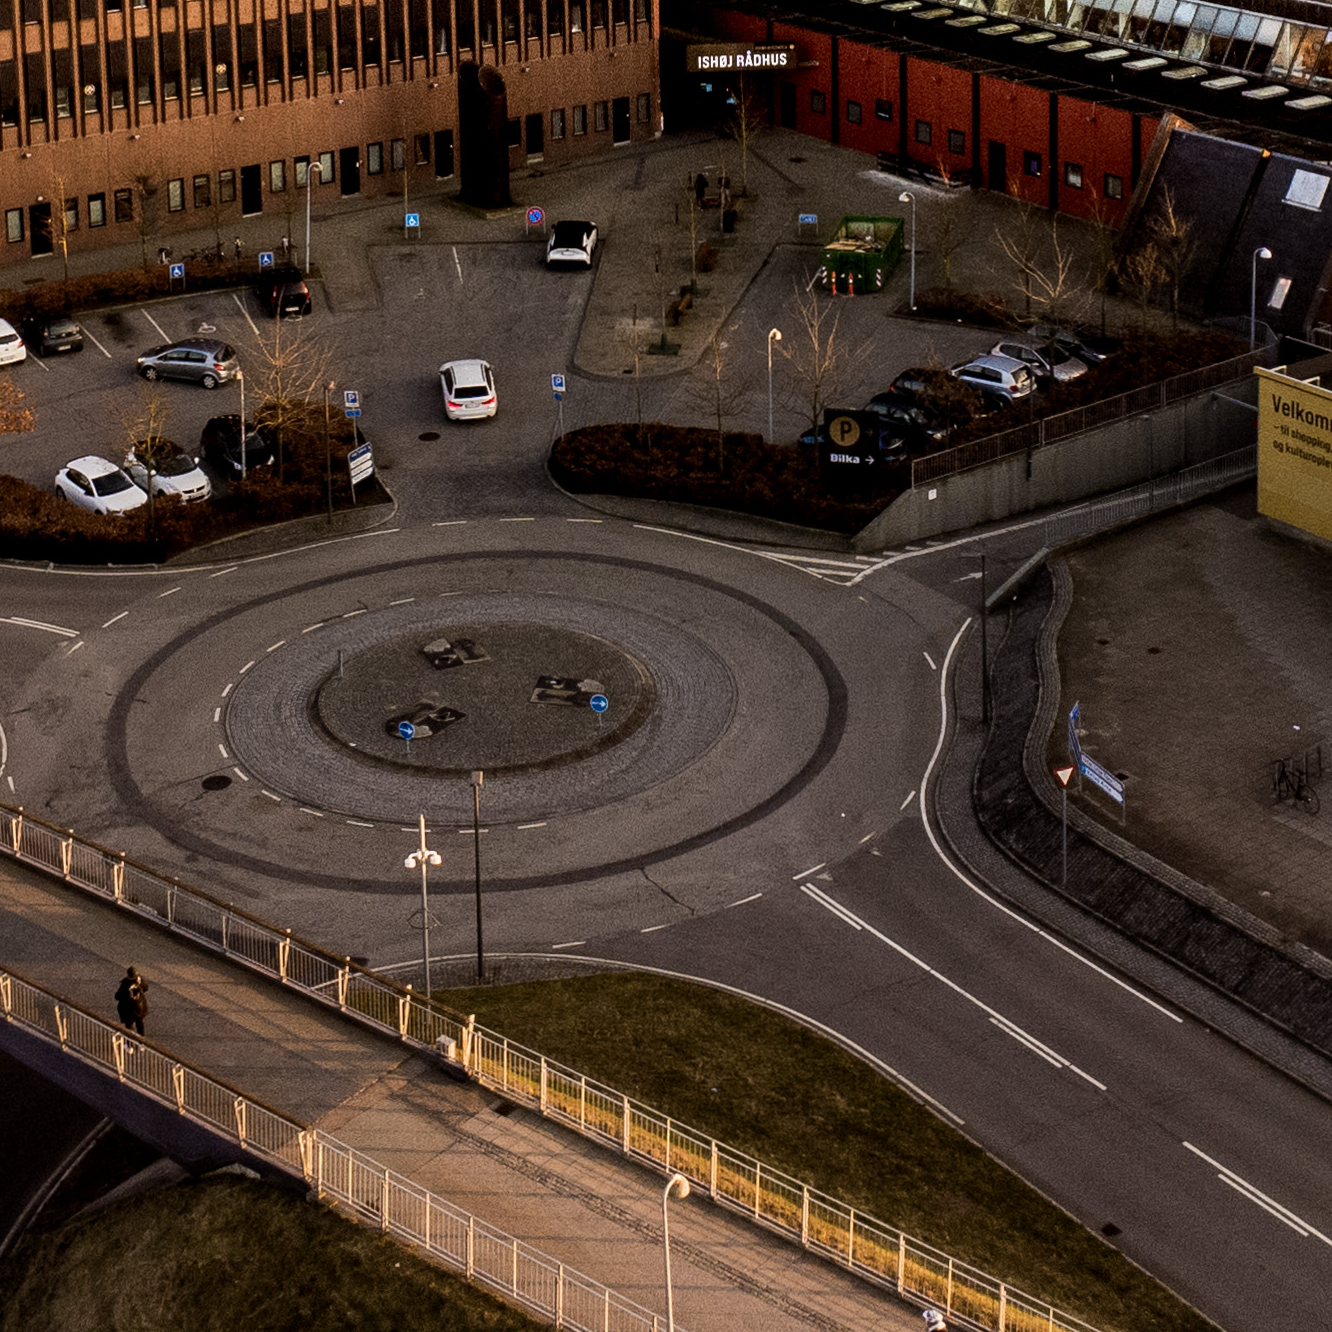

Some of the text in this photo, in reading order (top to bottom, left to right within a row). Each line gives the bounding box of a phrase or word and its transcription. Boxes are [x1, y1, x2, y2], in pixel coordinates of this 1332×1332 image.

[698, 50, 787, 68] ISHØJ RÅDHUS
[840, 420, 852, 442] P
[830, 453, 860, 464] Bilka
